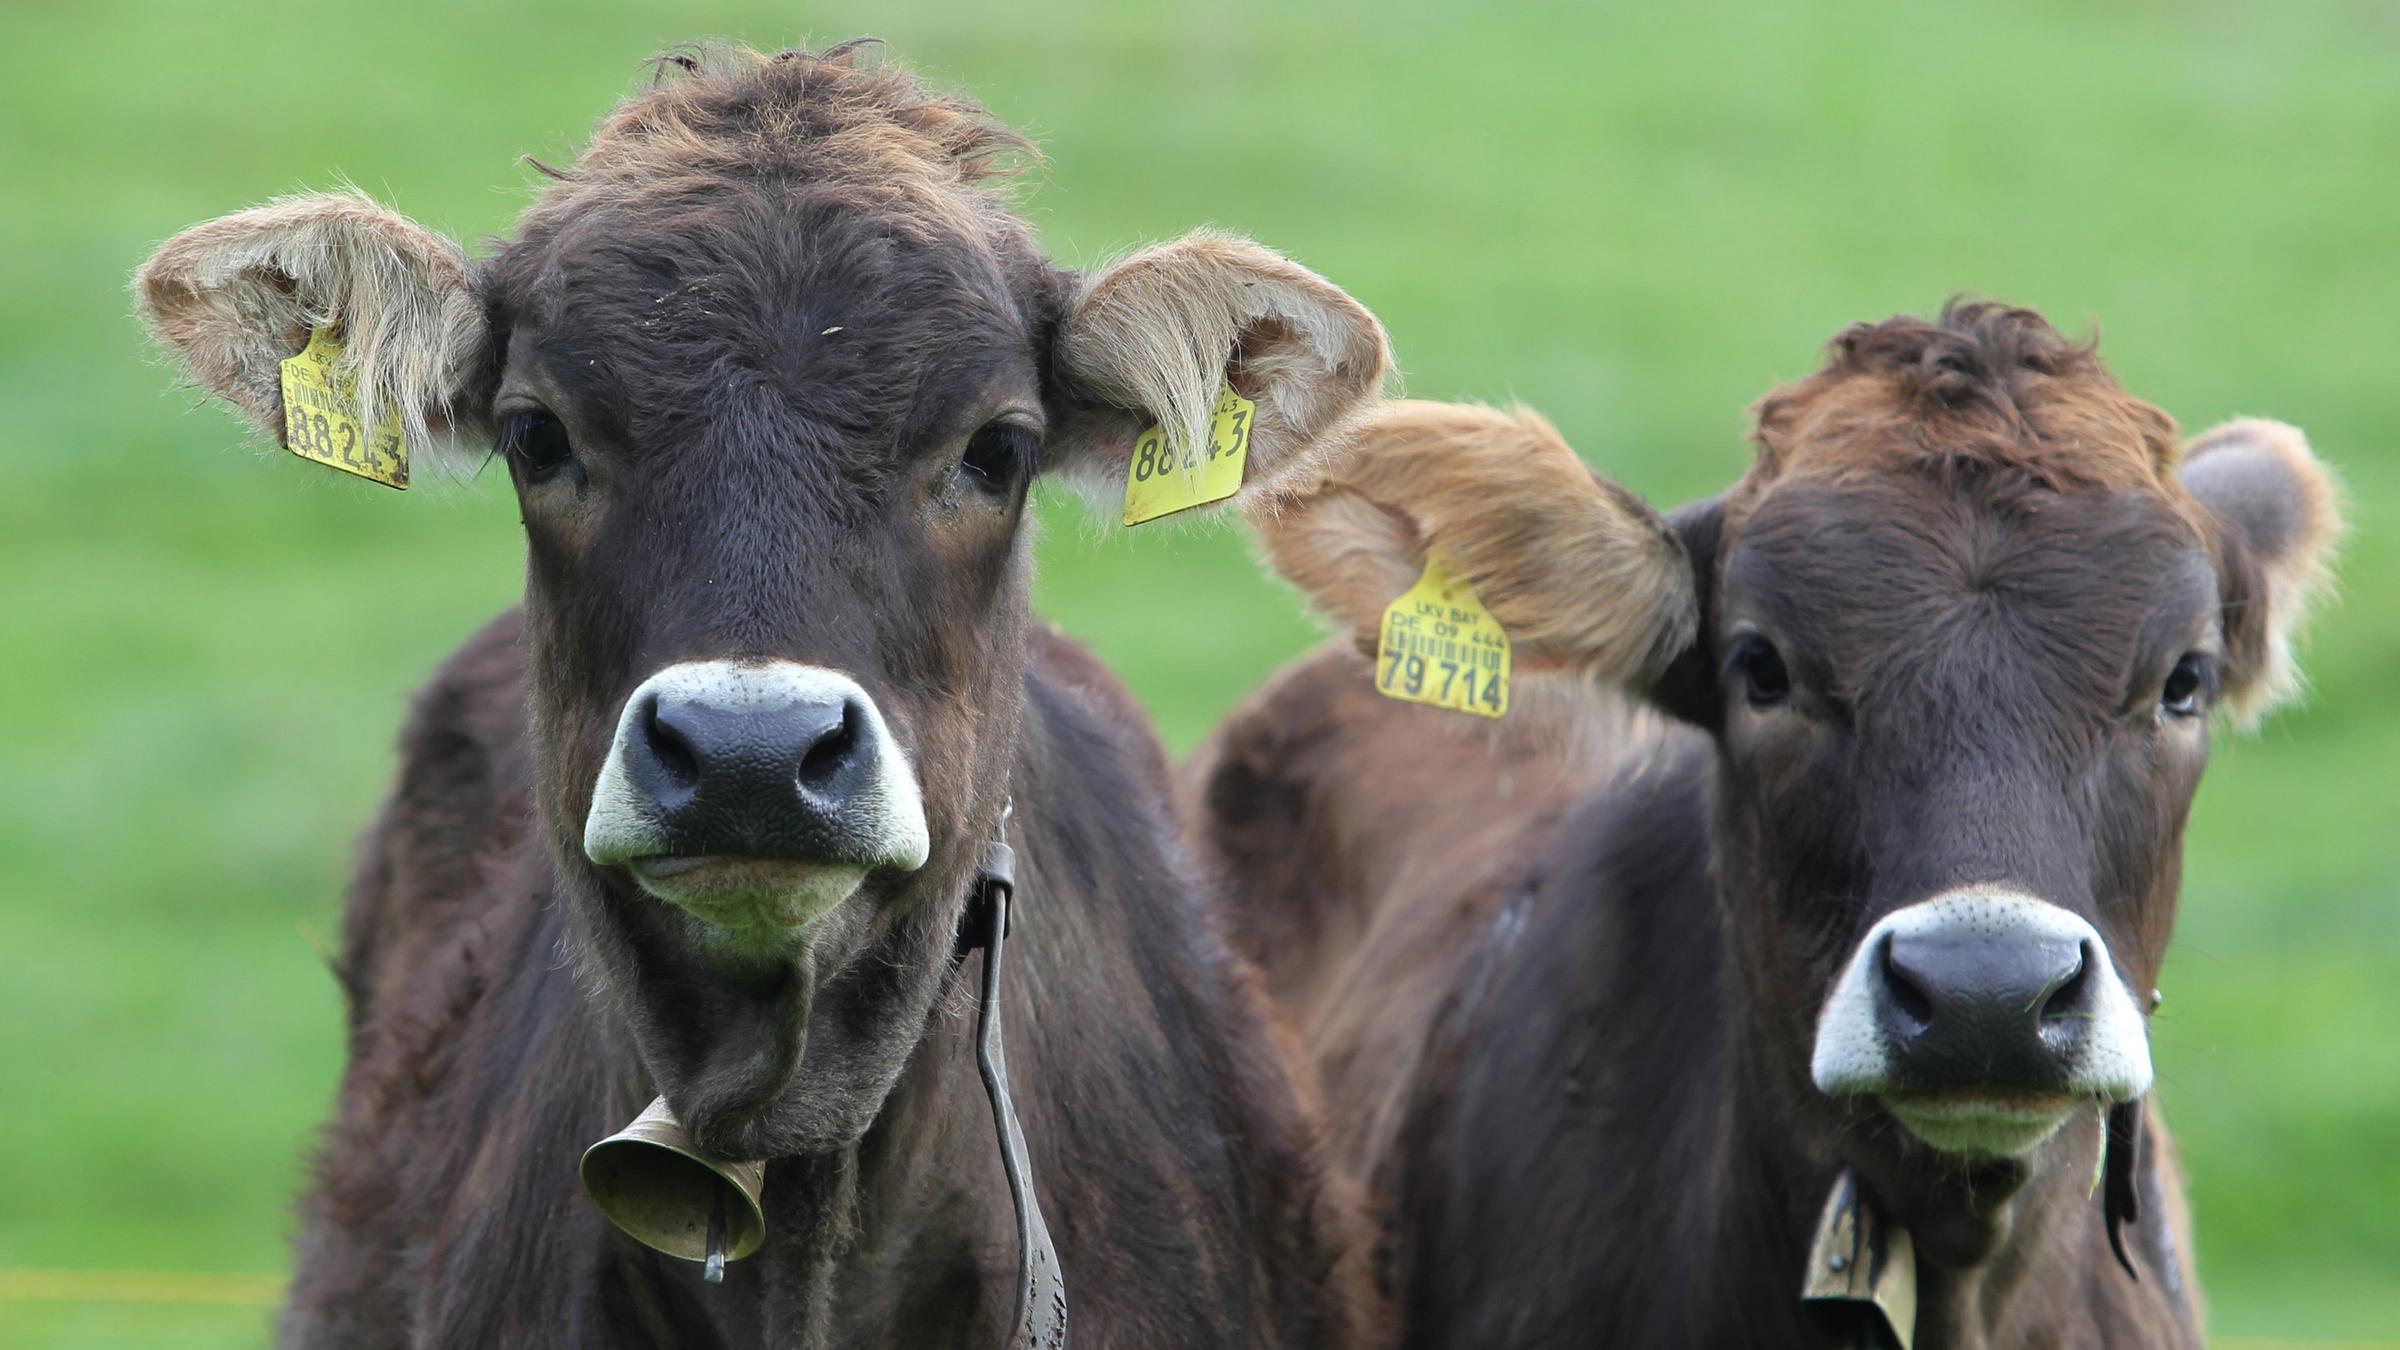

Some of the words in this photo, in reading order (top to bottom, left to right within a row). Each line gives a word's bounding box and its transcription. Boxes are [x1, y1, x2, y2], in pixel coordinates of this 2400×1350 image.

[291, 363, 311, 382] DE
[1391, 611, 1420, 629] DE
[1381, 650, 1425, 695] 79
[1440, 661, 1502, 712] 714
